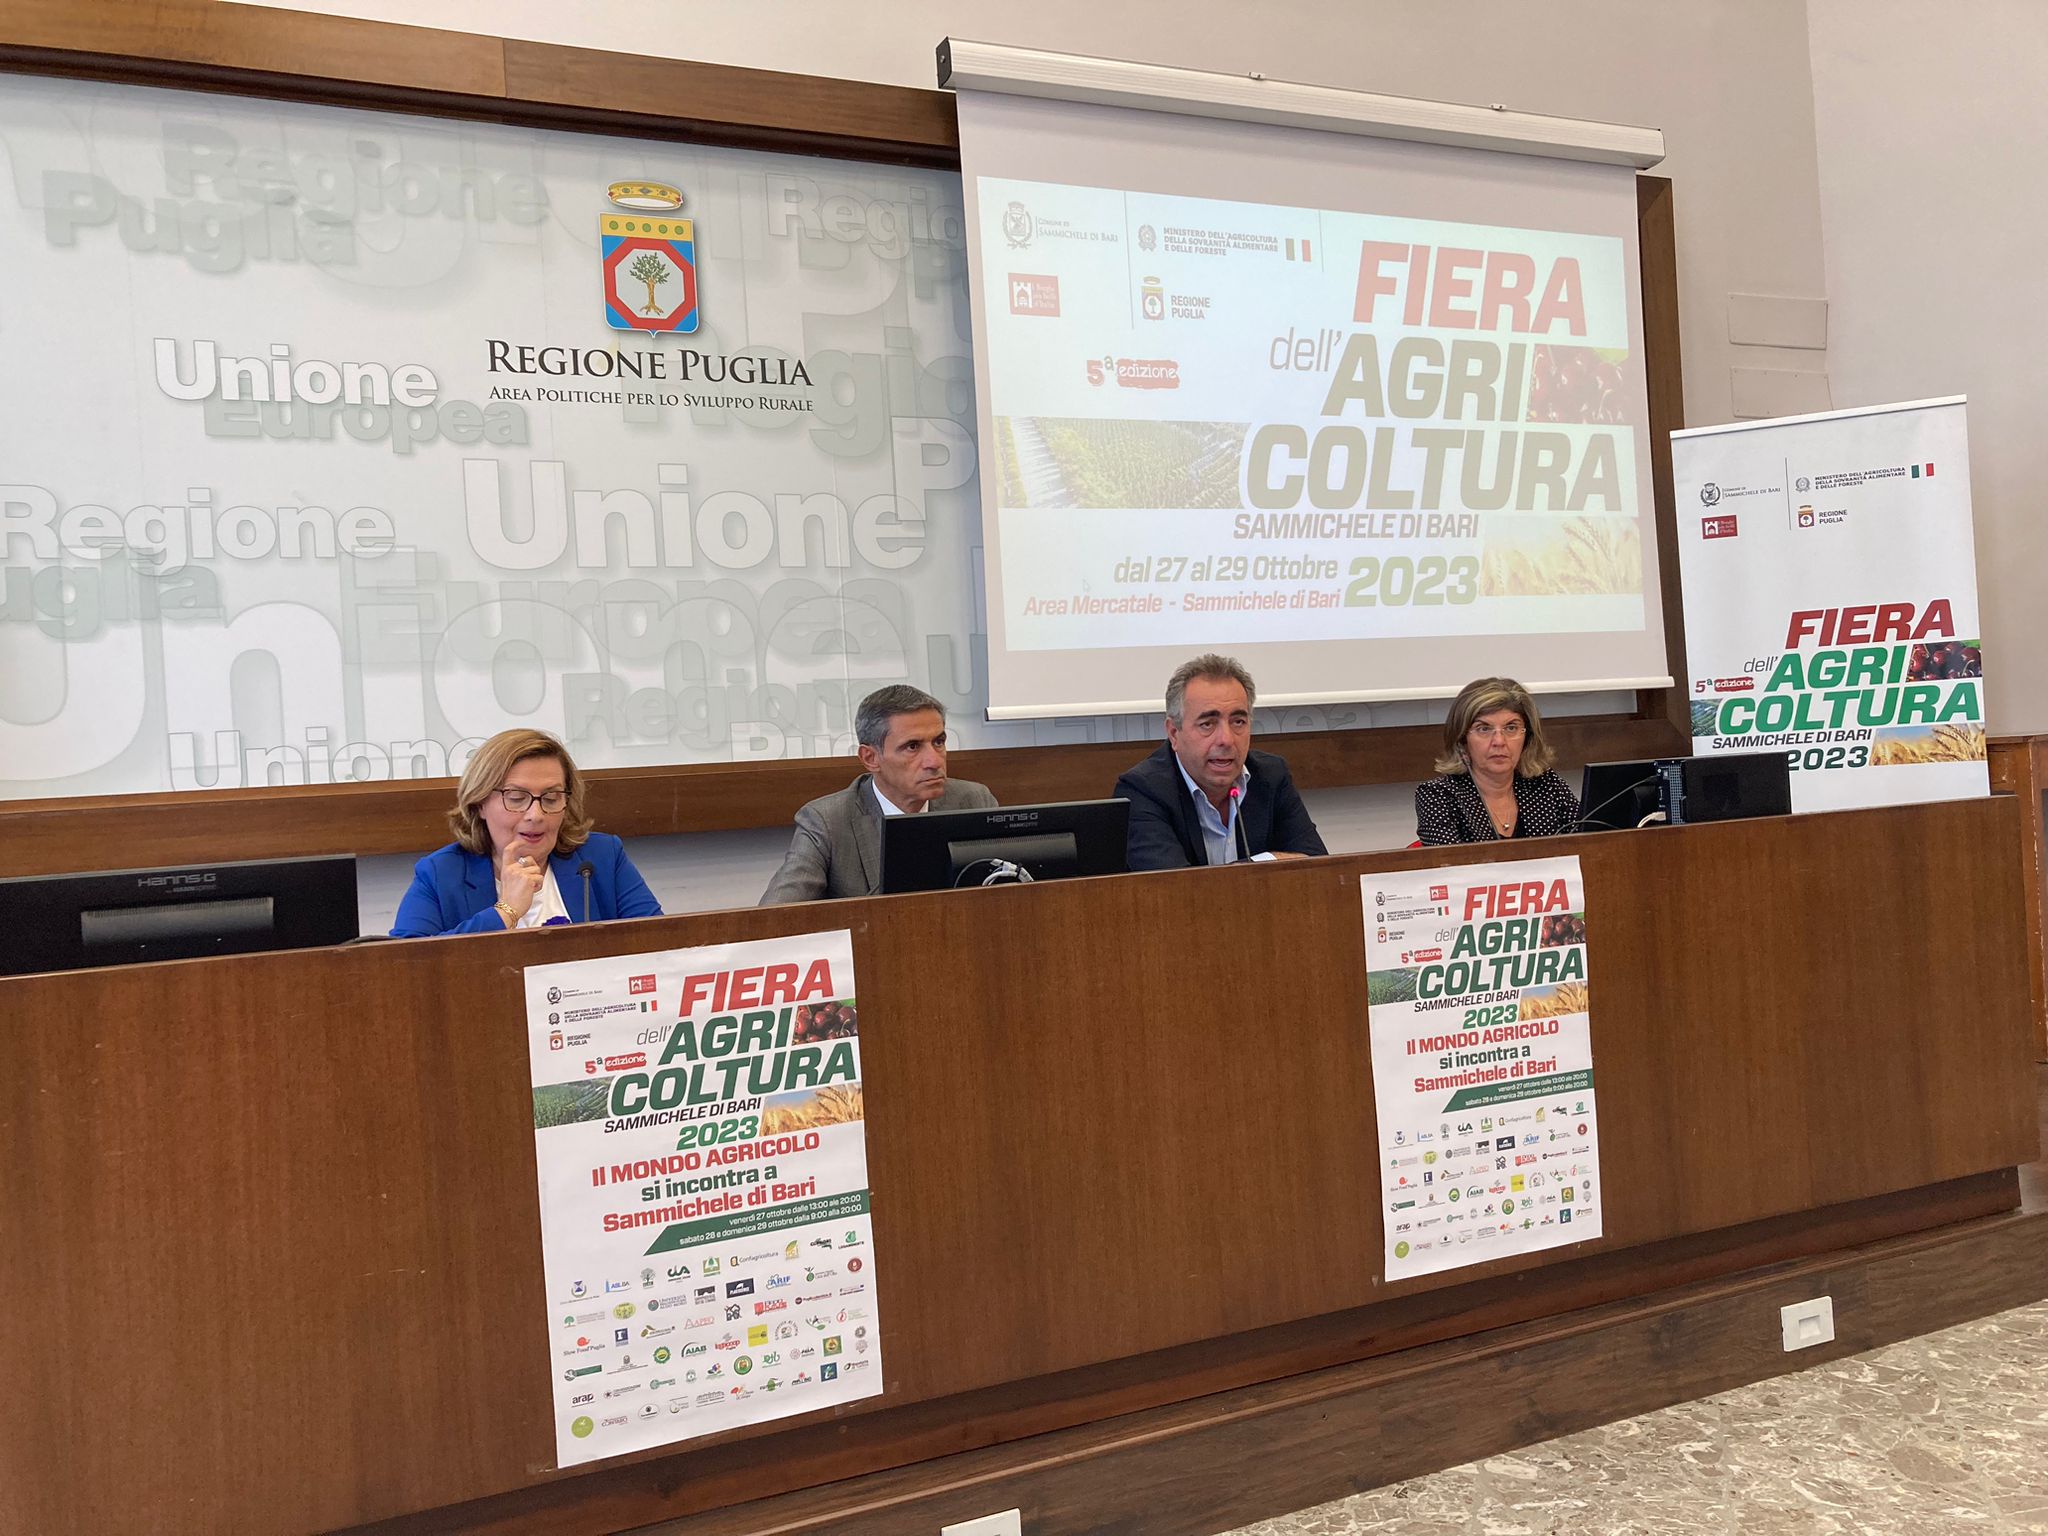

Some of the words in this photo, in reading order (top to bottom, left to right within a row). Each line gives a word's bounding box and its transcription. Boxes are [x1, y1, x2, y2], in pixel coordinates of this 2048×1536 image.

[1163, 227, 1206, 238] MINISTERO
[1164, 235, 1186, 244] DELLA
[1233, 241, 1279, 252] ALIMENTARE
[1171, 245, 1193, 254] DELLE
[1195, 247, 1227, 256] FORESTE
[1171, 295, 1211, 308] REGIONE
[1353, 240, 1587, 336] FIERA
[1171, 307, 1205, 319] PUGLIA
[154, 337, 439, 407] Unione
[1118, 362, 1178, 379] edizione
[1245, 423, 1623, 512] COLTURA
[1868, 471, 1906, 480] ALIMENTARE
[1838, 480, 1863, 488] FORESTE
[462, 458, 927, 570] Unione
[1233, 513, 1397, 539] SAMMICHELE
[1398, 514, 1422, 538] DI
[1425, 513, 1480, 539] BARI
[1818, 509, 1848, 518] REGIONE
[1819, 516, 1844, 525] PUGLIA
[0, 484, 397, 577] Regione
[1113, 556, 1152, 584] dal
[1153, 557, 1188, 583] 27
[1190, 555, 1213, 583] al
[1216, 555, 1248, 581] 29
[1252, 554, 1338, 581] Ottobre
[1344, 555, 1480, 608] 2023
[1024, 597, 1068, 616] Area
[1071, 593, 1163, 615] Mercatale
[1182, 590, 1287, 612] Sammichele
[1289, 589, 1304, 610] di
[1307, 588, 1341, 610] Bari
[1785, 598, 1955, 650] FIERA
[1715, 679, 1753, 689] edizione
[1718, 682, 1981, 736] COLTURA
[1712, 733, 1813, 750] SAMMICHELE
[1815, 731, 1832, 743] DI
[1833, 729, 1873, 742] BARI
[1463, 878, 1570, 921] FIERA
[1418, 947, 1584, 1000] COLTURA
[678, 958, 834, 1018] FIERA
[1414, 995, 1483, 1013] SAMMICHELE
[1484, 992, 1495, 1004] DI
[1495, 989, 1520, 1002] BARI
[1462, 1003, 1519, 1030] 2023
[567, 1033, 591, 1041] REGIONE
[567, 1039, 588, 1047] PUGLIA
[1419, 1032, 1479, 1053] MONDO
[1482, 1019, 1560, 1044] AGRICOLO
[605, 1055, 646, 1068] edizione
[1439, 1053, 1453, 1070] si
[1455, 1046, 1519, 1067] incontra
[1522, 1045, 1531, 1057] a
[611, 1041, 857, 1117] COLTURA
[1414, 1069, 1508, 1093] Sammichele
[1510, 1062, 1525, 1078] di
[1526, 1056, 1557, 1075] Bari
[1572, 1072, 1588, 1080] 20:00
[1573, 1080, 1588, 1088] 20:00
[604, 1107, 708, 1135] SAMMICHELE
[709, 1103, 726, 1117] DI
[727, 1097, 762, 1114] BARI
[676, 1115, 759, 1151] 2023
[611, 1153, 701, 1184] MONDO
[705, 1132, 821, 1168] AGRICOLO
[641, 1179, 661, 1202] si
[665, 1168, 760, 1198] incontra
[764, 1165, 778, 1182] a
[603, 1197, 743, 1233] Sammichele
[747, 1186, 767, 1207] di
[771, 1176, 816, 1202] Bari
[729, 1214, 756, 1226] venerdì
[756, 1212, 766, 1221] 27
[766, 1208, 792, 1219] ottobre
[809, 1200, 829, 1210] 13:00
[840, 1194, 861, 1205] 20:00
[679, 1235, 705, 1245] sabato
[705, 1231, 716, 1239] 28
[722, 1225, 757, 1237] domenica
[757, 1222, 767, 1230] 29
[768, 1217, 794, 1229] ottobre
[811, 1210, 828, 1220] 9:00
[840, 1204, 862, 1214] 20:00
[685, 1345, 707, 1355] AIAB
[572, 1393, 594, 1405] arap
